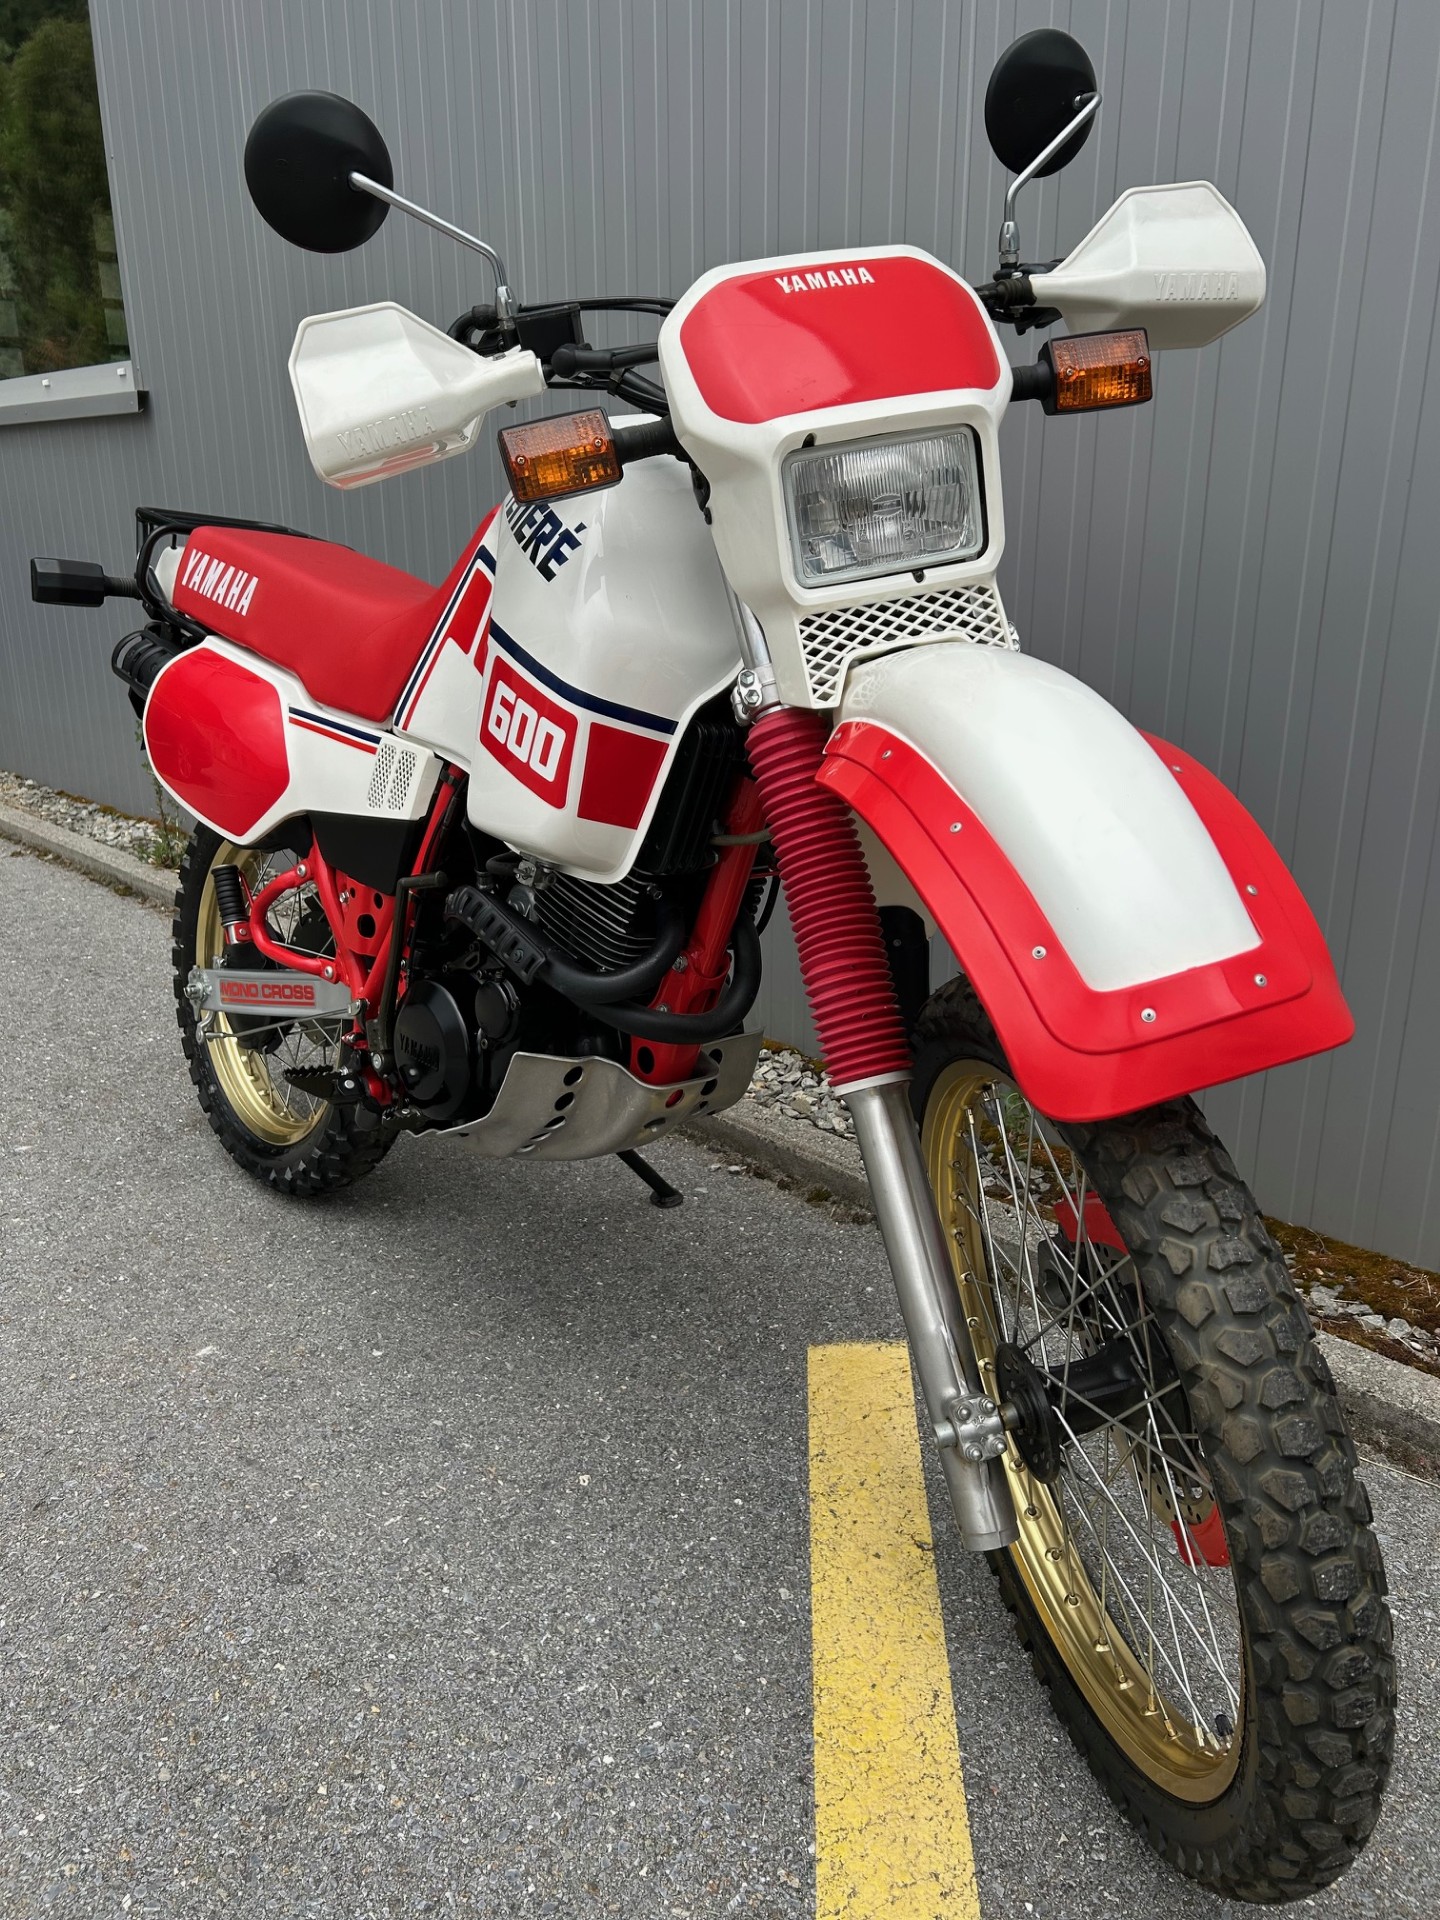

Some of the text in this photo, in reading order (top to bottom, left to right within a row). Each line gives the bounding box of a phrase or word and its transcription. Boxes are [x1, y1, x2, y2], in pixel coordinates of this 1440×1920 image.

[774, 266, 876, 294] YAMAHA
[1152, 271, 1239, 301] YAMAHA
[336, 405, 437, 461] YAMAHA
[181, 548, 259, 617] YAMAHA
[487, 679, 567, 783] 600
[221, 981, 316, 1001] MONO CROSS
